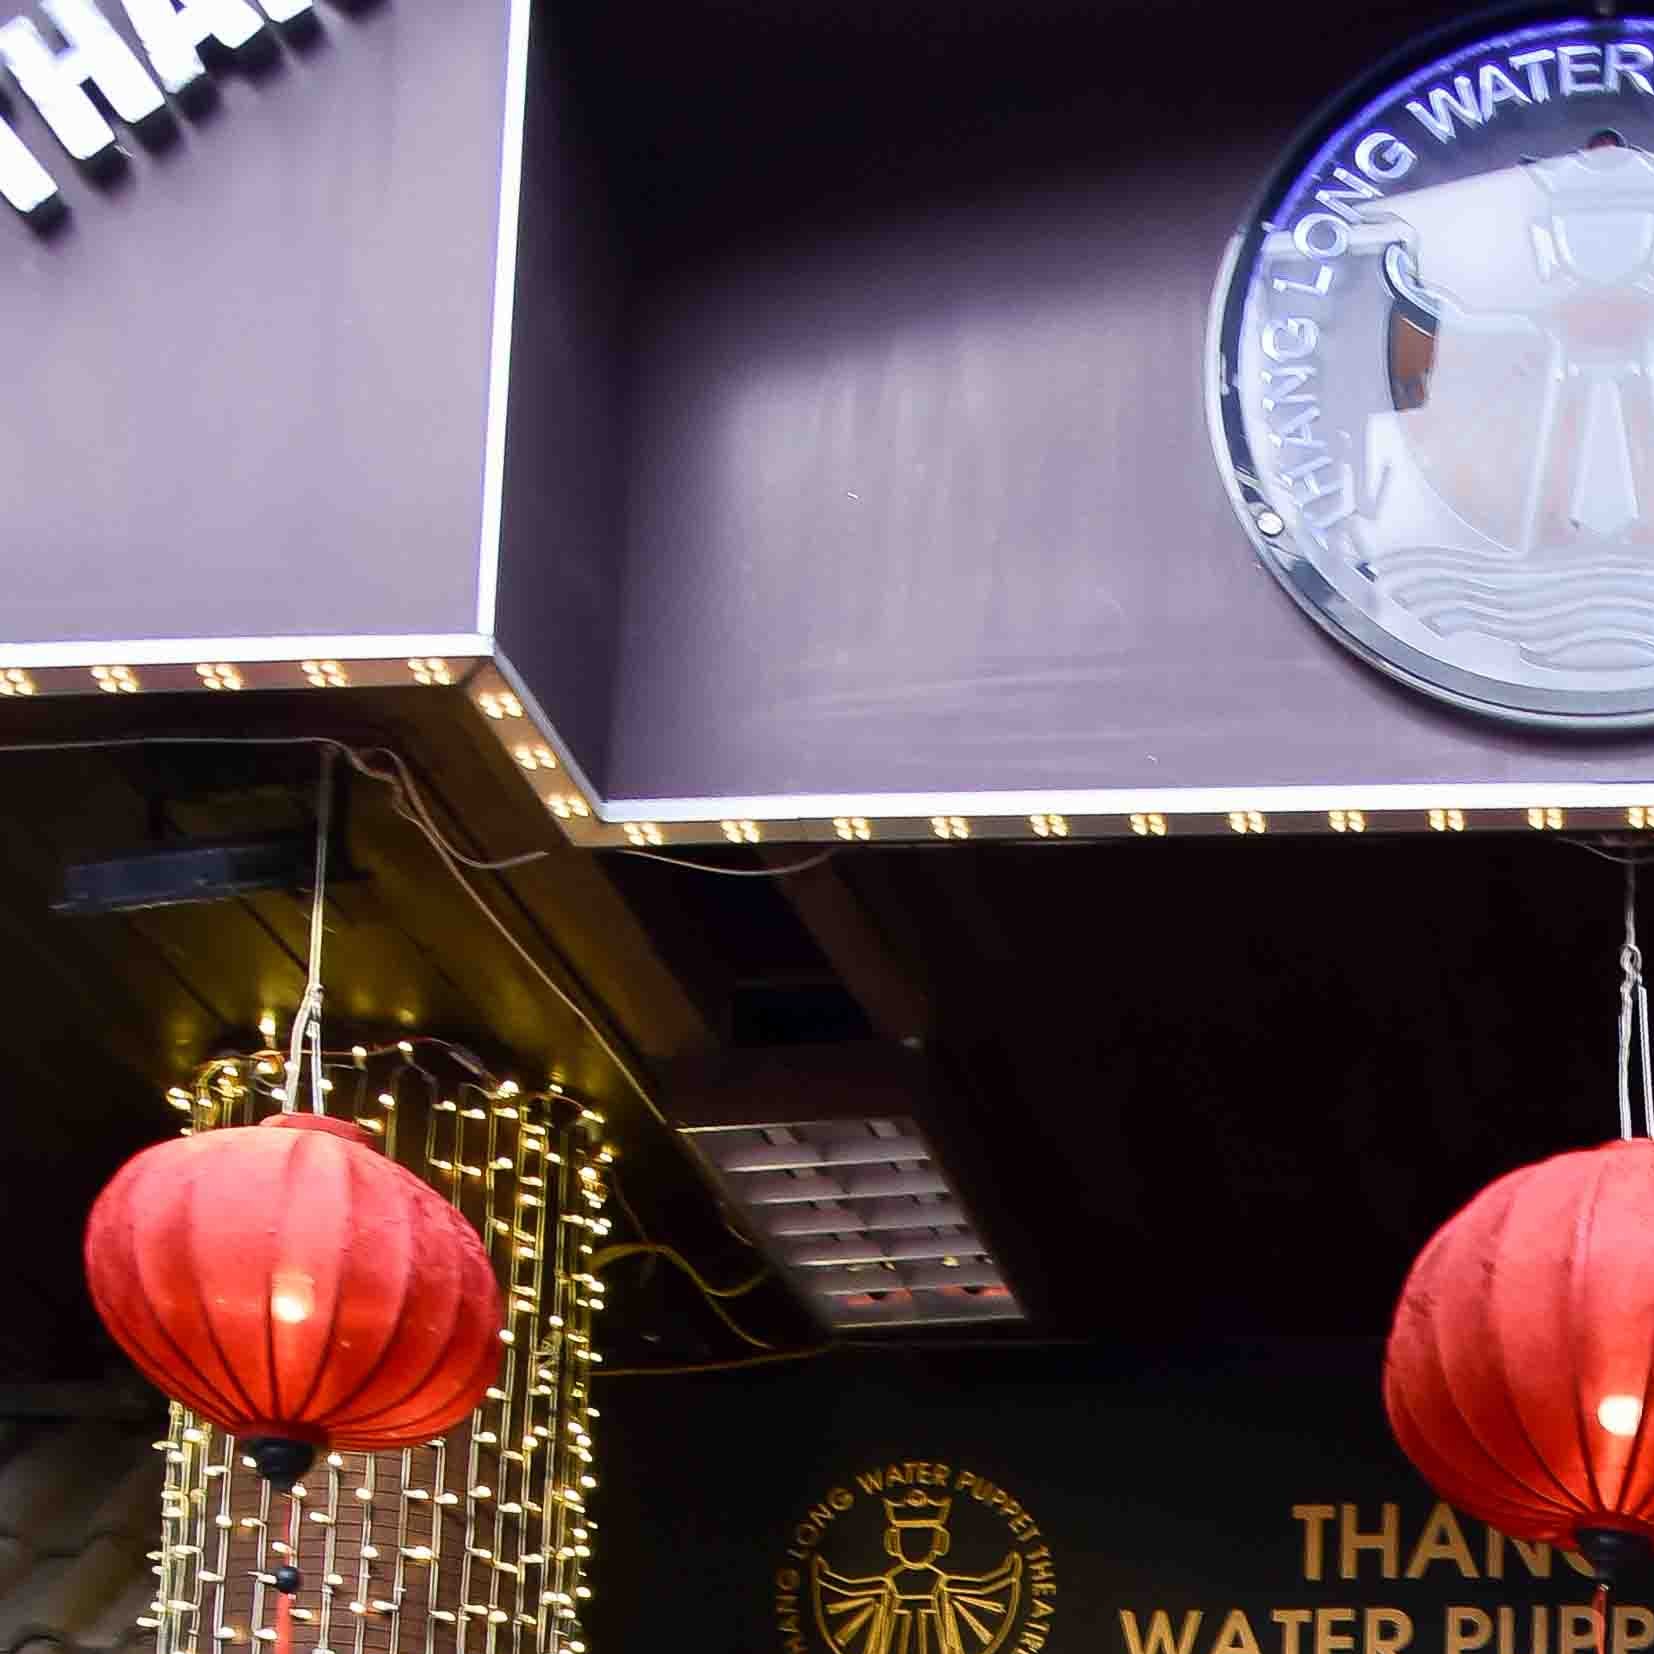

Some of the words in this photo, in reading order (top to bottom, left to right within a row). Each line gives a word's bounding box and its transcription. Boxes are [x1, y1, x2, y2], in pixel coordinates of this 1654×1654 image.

[1273, 131, 1416, 297] LONG
[1405, 42, 1654, 145] WATER
[856, 1462, 952, 1496] WATER
[1292, 1500, 1598, 1580] THAN
